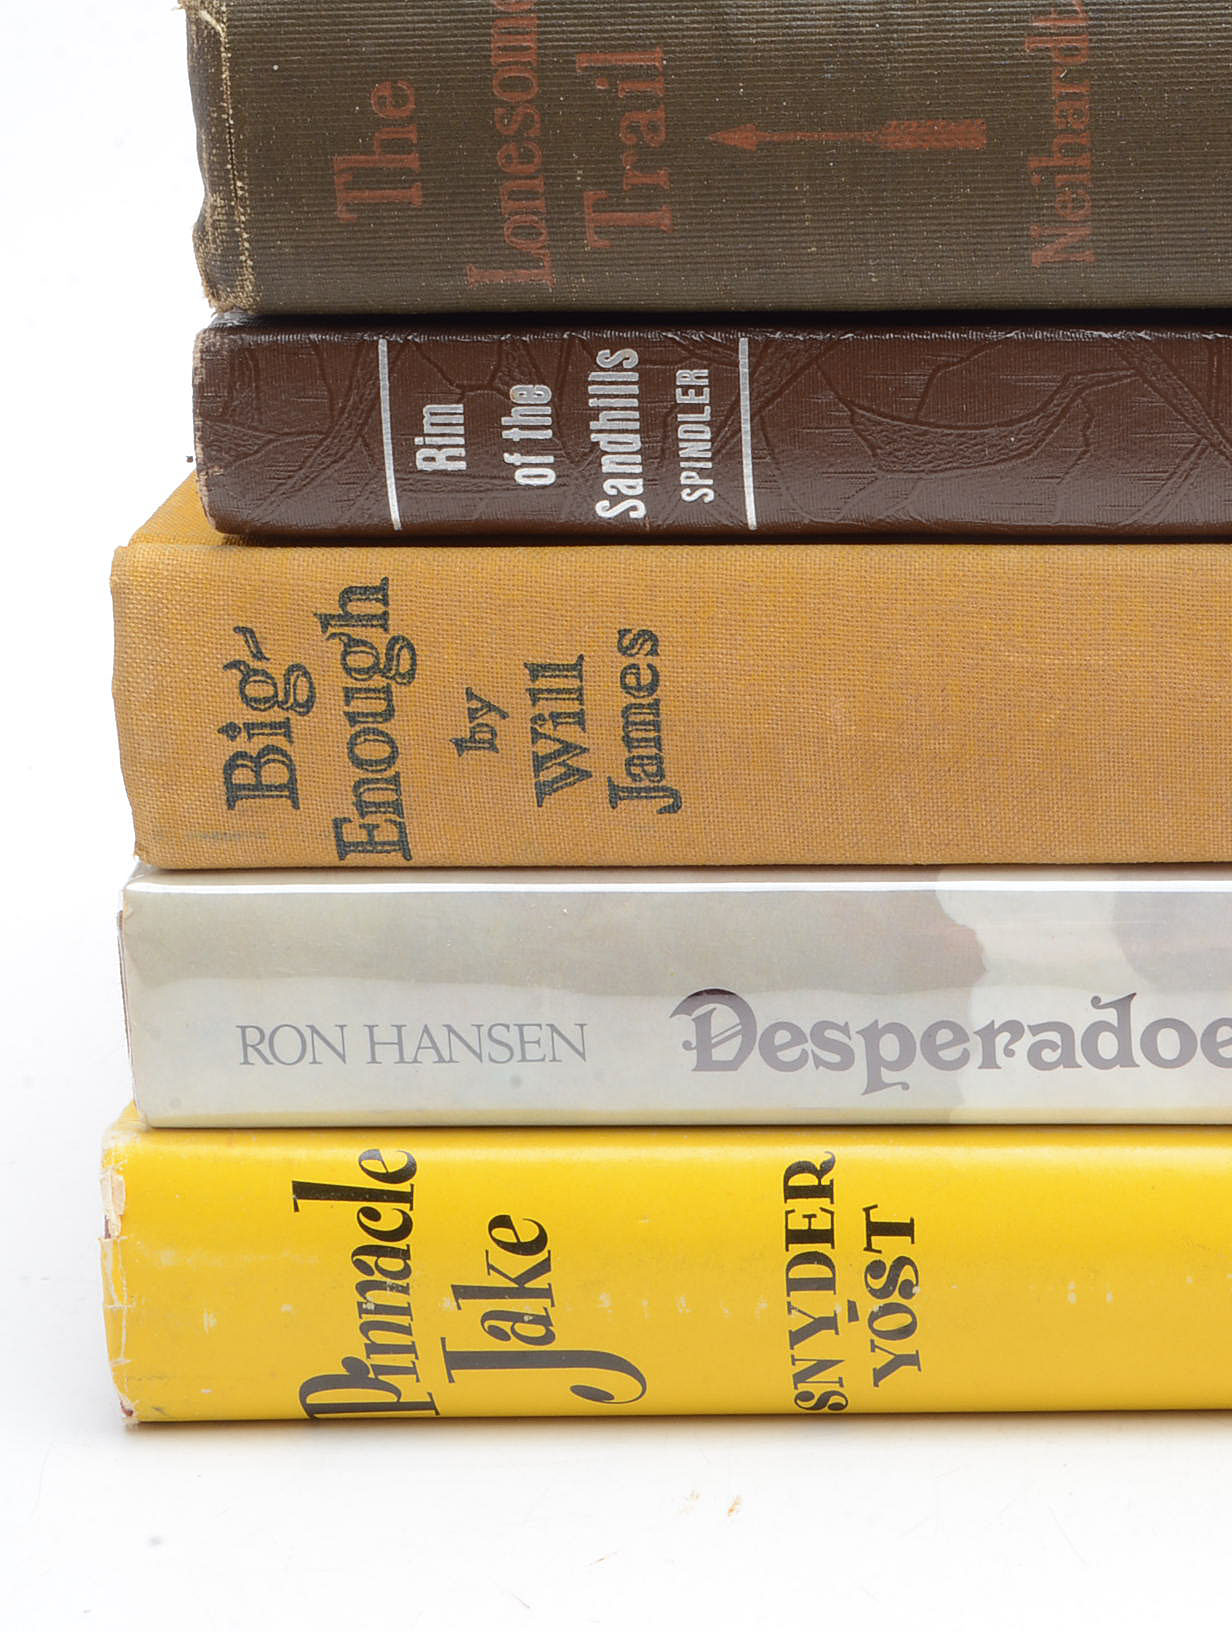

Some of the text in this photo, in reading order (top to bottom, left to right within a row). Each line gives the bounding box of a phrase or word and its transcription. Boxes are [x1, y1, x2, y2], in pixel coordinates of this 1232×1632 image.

[332, 79, 422, 223] The
[576, 46, 673, 249] Trail
[1024, 0, 1096, 268] Neihardt
[415, 403, 467, 472] Rim
[501, 384, 556, 487] of the
[587, 348, 646, 519] Sandhills
[676, 368, 714, 504] SPINDLER
[314, 576, 416, 861] Enough
[450, 687, 509, 757] by
[523, 653, 592, 808] Will
[608, 627, 683, 815] James
[235, 1022, 589, 1067] RON HANSEN
[291, 1148, 440, 1418] Pinnacle
[440, 1213, 647, 1405] Jake
[783, 1150, 849, 1411] SNYDER
[862, 1203, 922, 1388] YOST
